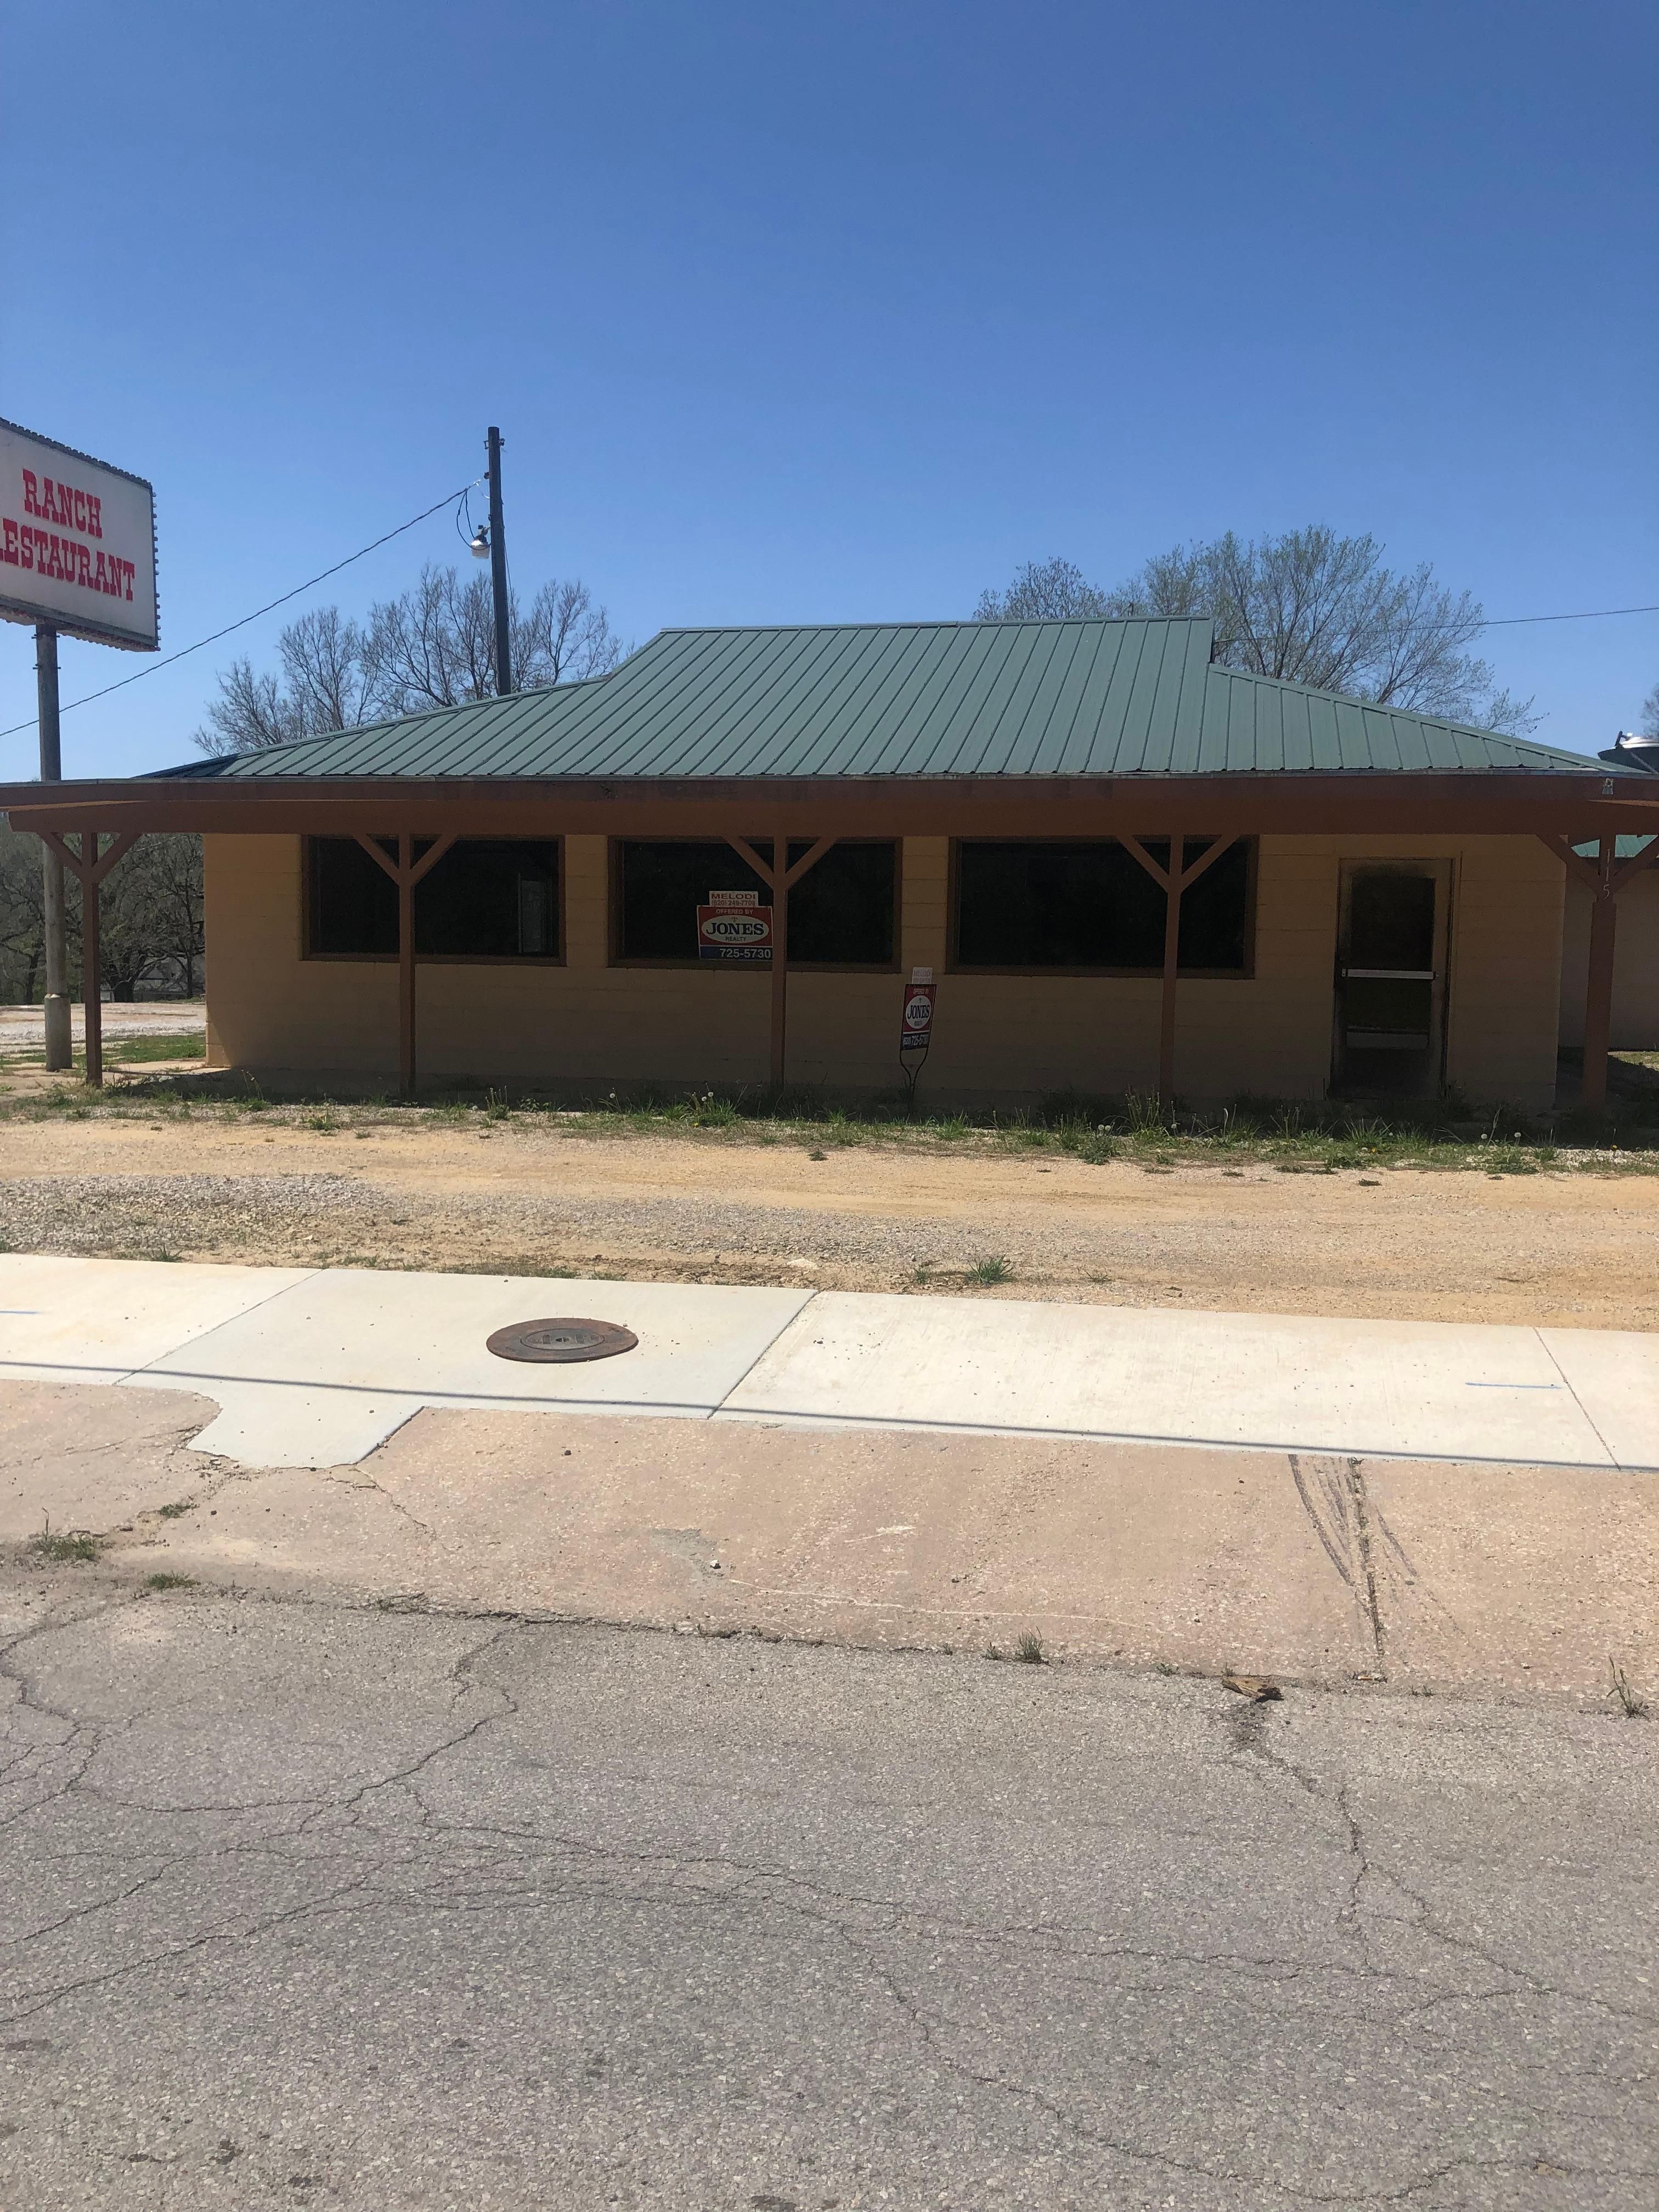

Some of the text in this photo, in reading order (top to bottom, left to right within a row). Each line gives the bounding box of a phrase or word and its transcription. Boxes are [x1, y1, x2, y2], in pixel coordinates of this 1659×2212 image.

[22, 469, 103, 539] RANCH
[0, 517, 136, 602] ESTAURANT
[706, 922, 764, 935] JONES
[719, 948, 771, 958] 725-5730
[907, 1005, 930, 1019] JONES
